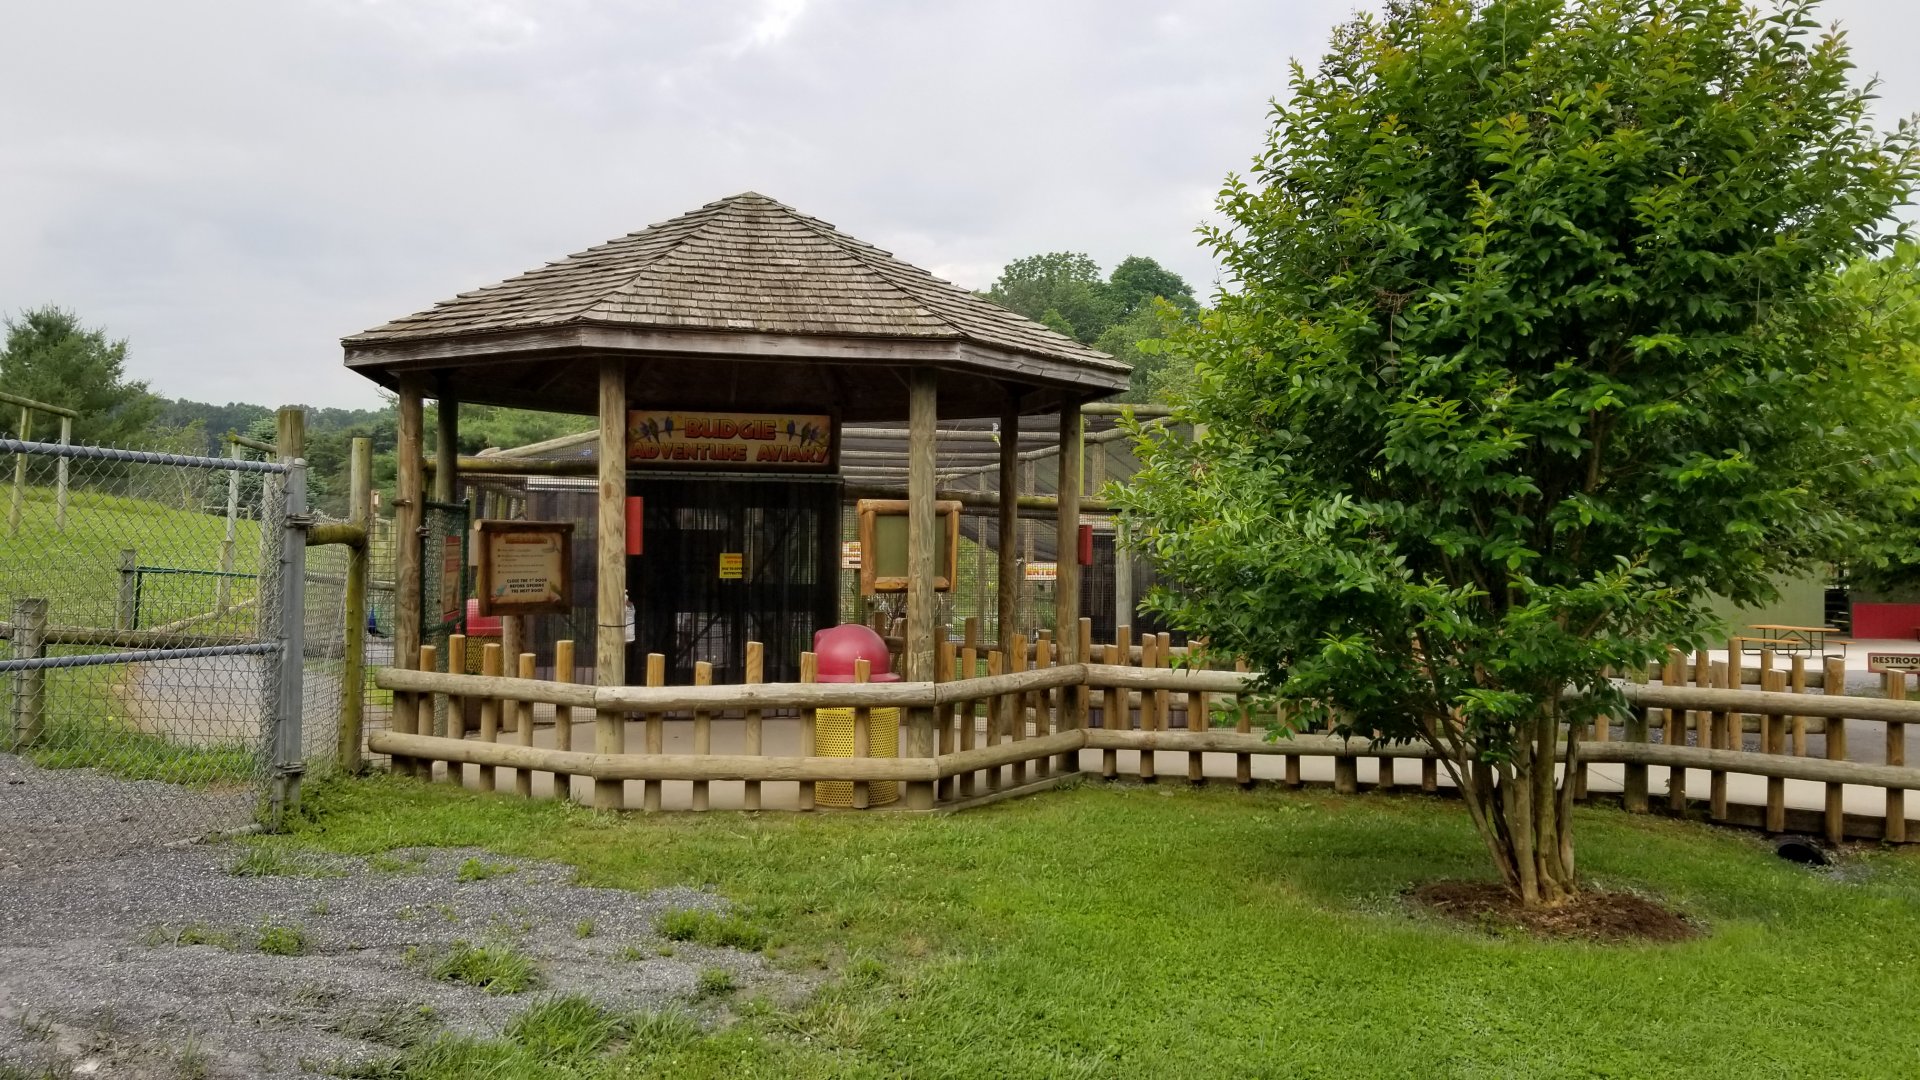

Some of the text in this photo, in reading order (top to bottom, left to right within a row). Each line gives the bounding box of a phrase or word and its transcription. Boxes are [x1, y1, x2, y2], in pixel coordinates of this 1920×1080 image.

[685, 418, 776, 440] BUDGIE
[630, 441, 829, 462] ADVENTURE AVIARY
[1872, 656, 1920, 664] RESTROO
